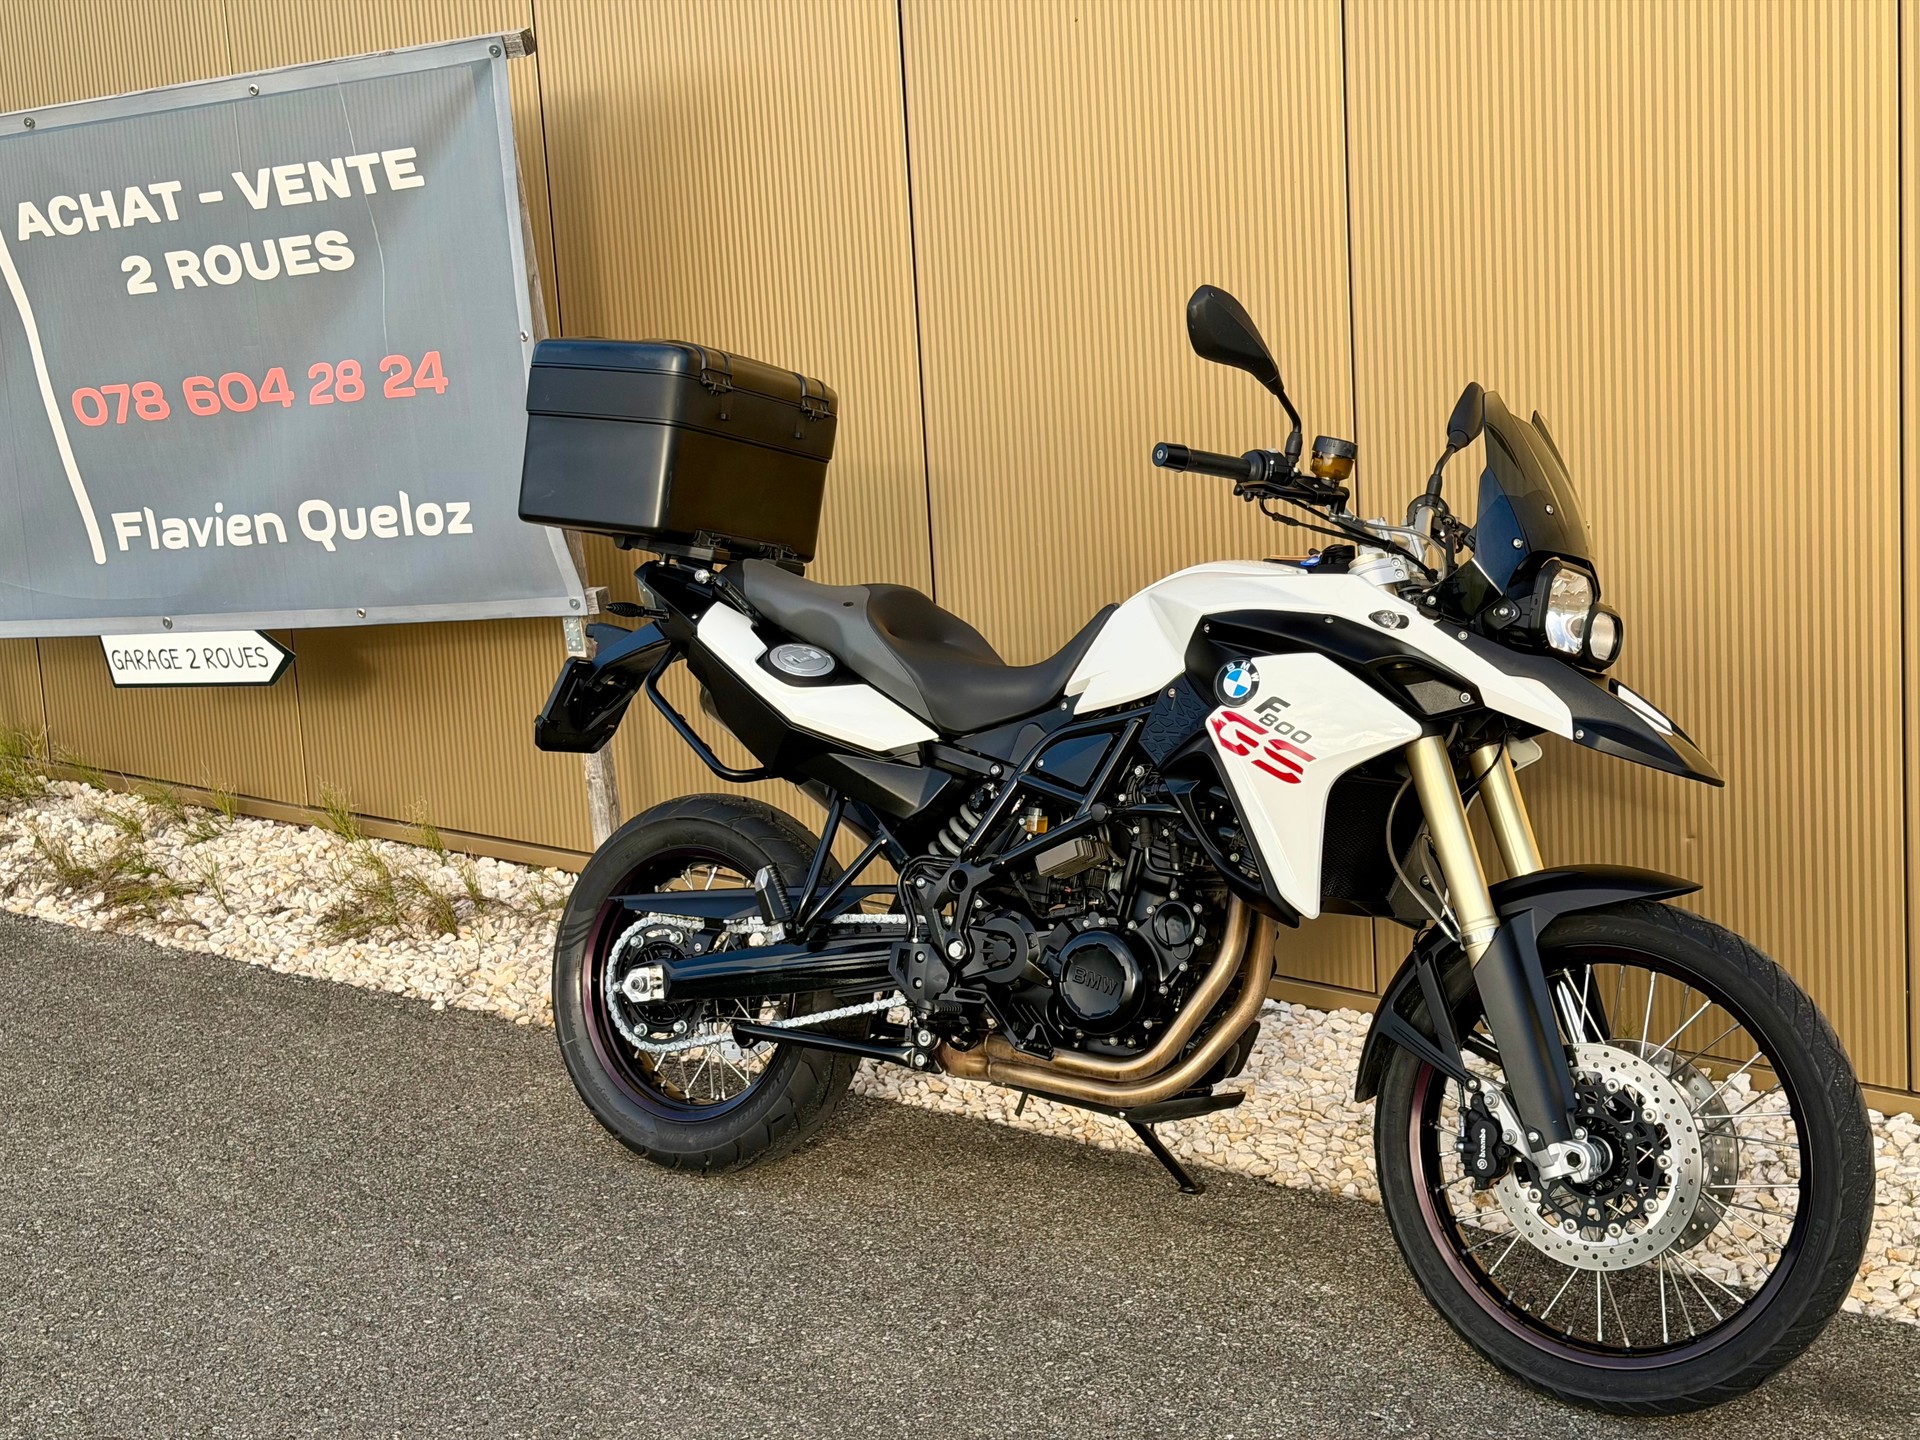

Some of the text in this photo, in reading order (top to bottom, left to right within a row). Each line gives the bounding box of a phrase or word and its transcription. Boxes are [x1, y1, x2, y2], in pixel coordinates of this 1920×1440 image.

[17, 146, 427, 241] ACHAT - VENTE
[120, 230, 356, 296] 2 ROUES
[71, 351, 449, 426] 078 604 28 24
[111, 490, 475, 552] Flavien Queloz
[111, 646, 269, 671] GARAGE 2 ROUES
[1226, 661, 1260, 682] BMW
[1209, 710, 1317, 785] GS
[1253, 695, 1313, 745] F 800
[1072, 966, 1119, 996] BMW
